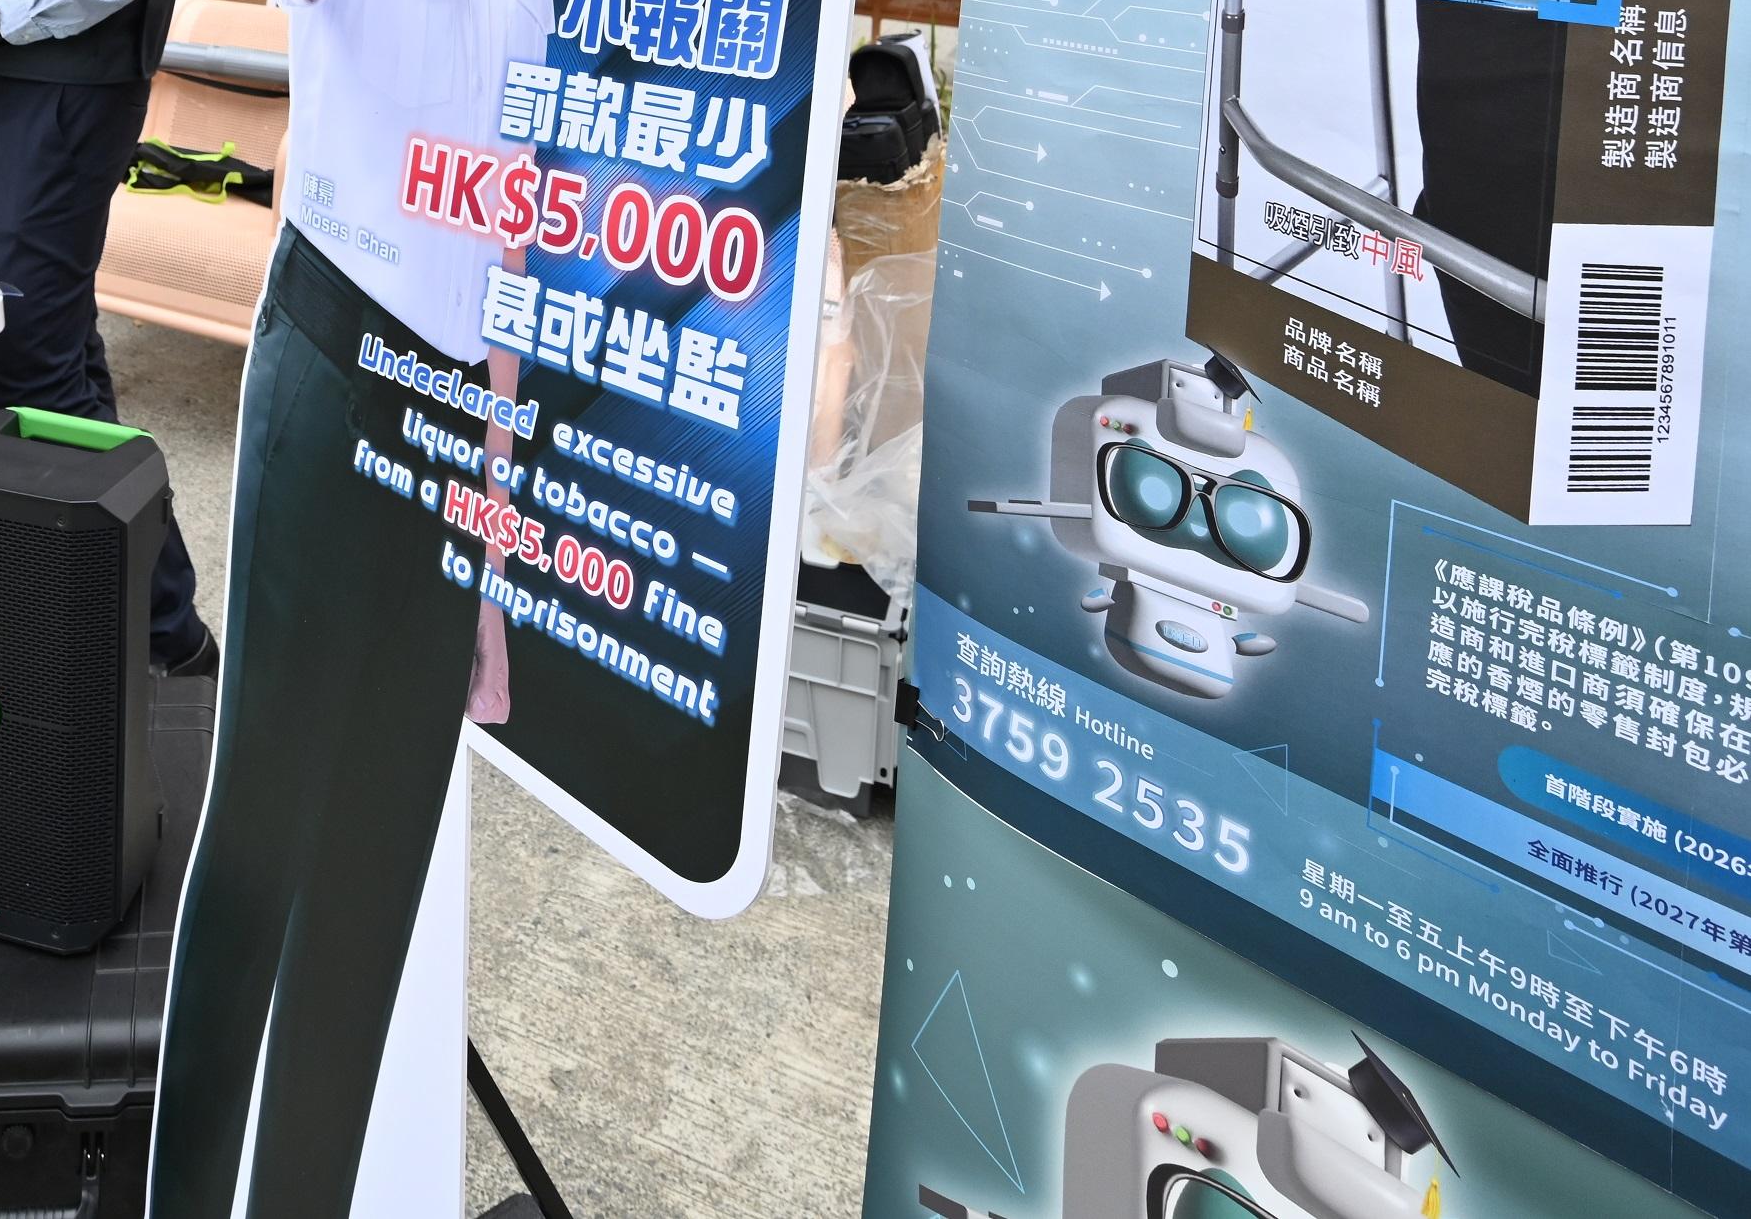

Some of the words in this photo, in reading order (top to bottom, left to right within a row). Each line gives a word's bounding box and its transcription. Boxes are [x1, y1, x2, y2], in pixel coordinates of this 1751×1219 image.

[499, 62, 767, 184] 罰款最少
[1600, 4, 1646, 169] 製造商名稱
[1644, 7, 1689, 170] 製造商信息
[301, 204, 348, 241] Moses
[357, 229, 400, 263] Chan
[303, 172, 334, 206] 陳豪
[402, 139, 764, 301] HK$5,000
[1263, 201, 1424, 283] 吸煙引致中風
[481, 264, 749, 430] 甚或坐監
[1282, 344, 1382, 409] 商品名稱
[1284, 317, 1383, 381] 品牌名稱
[1656, 316, 1677, 443] 1234567891011
[358, 333, 539, 440] Undeclared
[552, 421, 736, 520] excessive
[402, 408, 486, 473] liquor
[491, 454, 526, 488] or
[532, 466, 676, 561] tobacco
[419, 482, 438, 505] a
[442, 479, 634, 611] HK$5,000
[441, 541, 473, 587] to
[480, 563, 717, 721] imprisonment
[956, 632, 1067, 719] 查詢熱線
[1075, 705, 1155, 761] Hotline
[1425, 667, 1552, 732] 完稅標籤。
[1430, 612, 1751, 756] 造商和進口商須確保在
[952, 676, 1070, 781] 3759
[1093, 760, 1251, 874] 2535
[1427, 640, 1750, 785] 應的香煙的零售封包必
[1528, 840, 1623, 896] 全面推行
[1545, 773, 1667, 844] 首階段實施
[1674, 830, 1751, 878] (2026
[1299, 888, 1314, 910] 9
[1318, 903, 1358, 935] am
[1364, 921, 1390, 951] to
[1395, 937, 1411, 961] 6
[1418, 950, 1460, 988] pm
[1468, 973, 1581, 1053] Monday
[1587, 1039, 1618, 1069] to
[1627, 1057, 1729, 1132] Friday
[1301, 857, 1728, 1097] 星期一至五上午9時至下午6時
